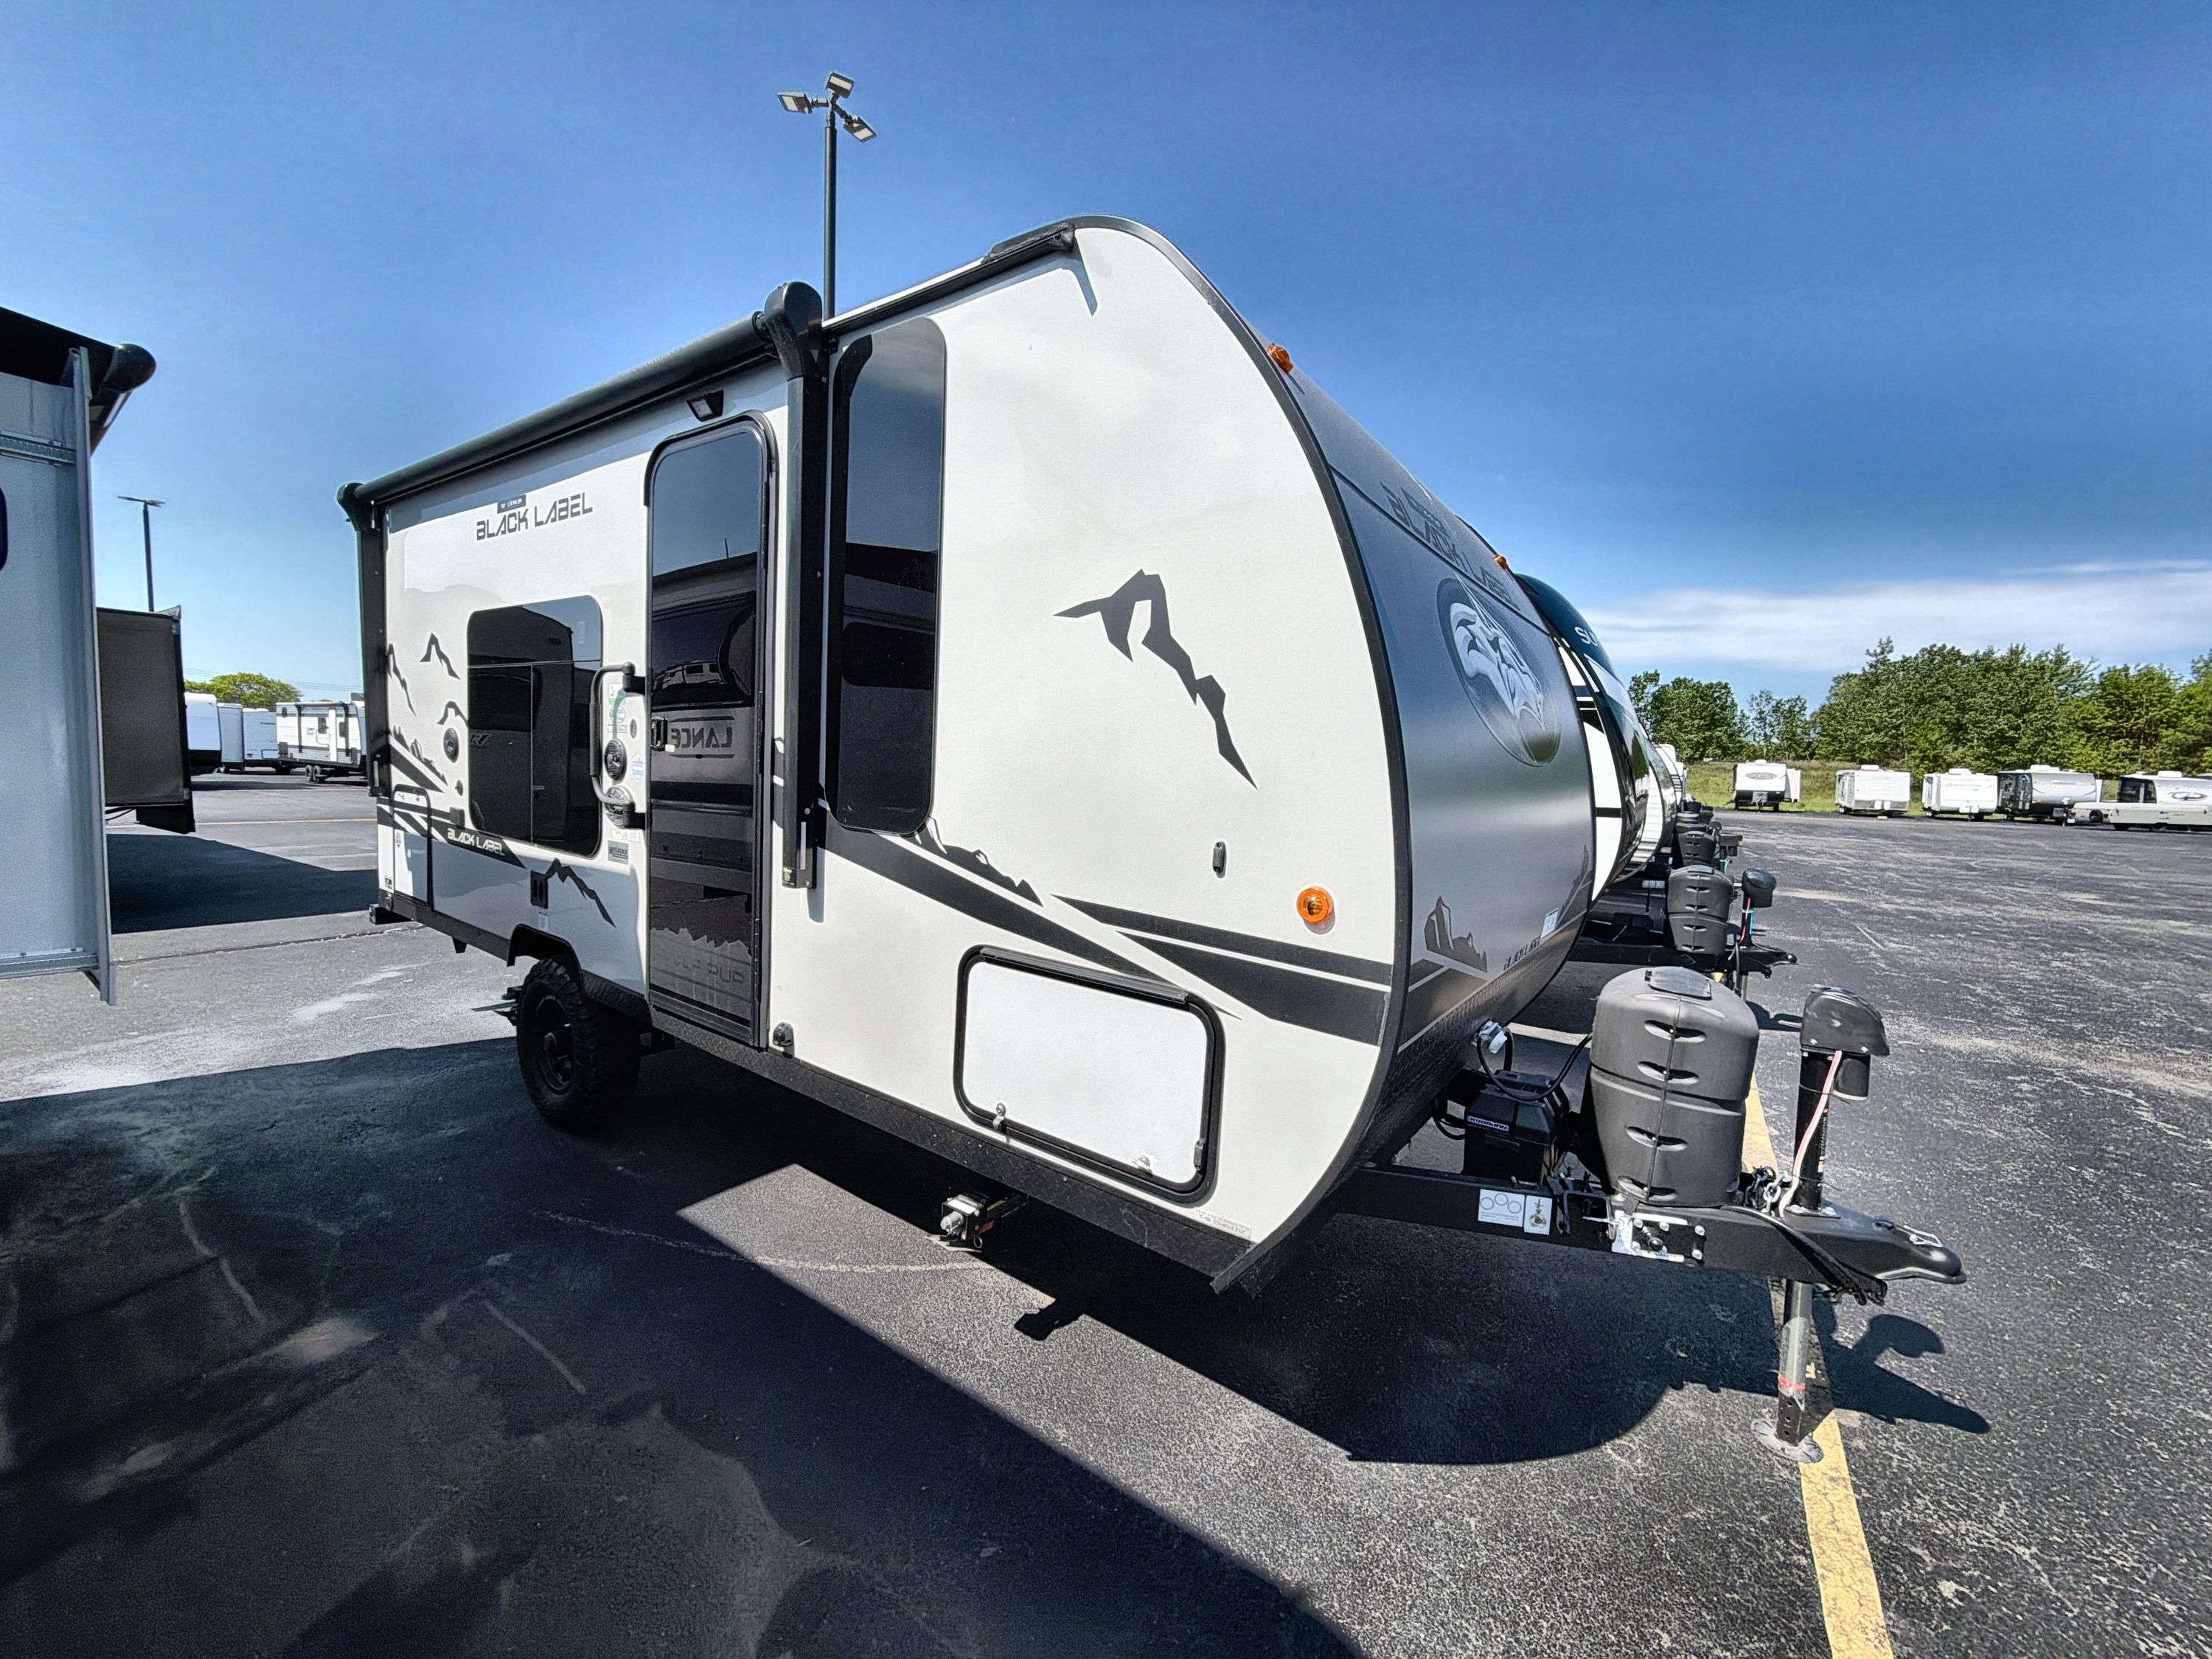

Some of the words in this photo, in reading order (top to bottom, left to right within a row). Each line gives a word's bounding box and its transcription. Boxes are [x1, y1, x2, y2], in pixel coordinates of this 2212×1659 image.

[476, 508, 529, 540] BLACK
[534, 492, 593, 527] LABEL
[447, 827, 475, 846] BLACK
[476, 836, 506, 856] LABEL
